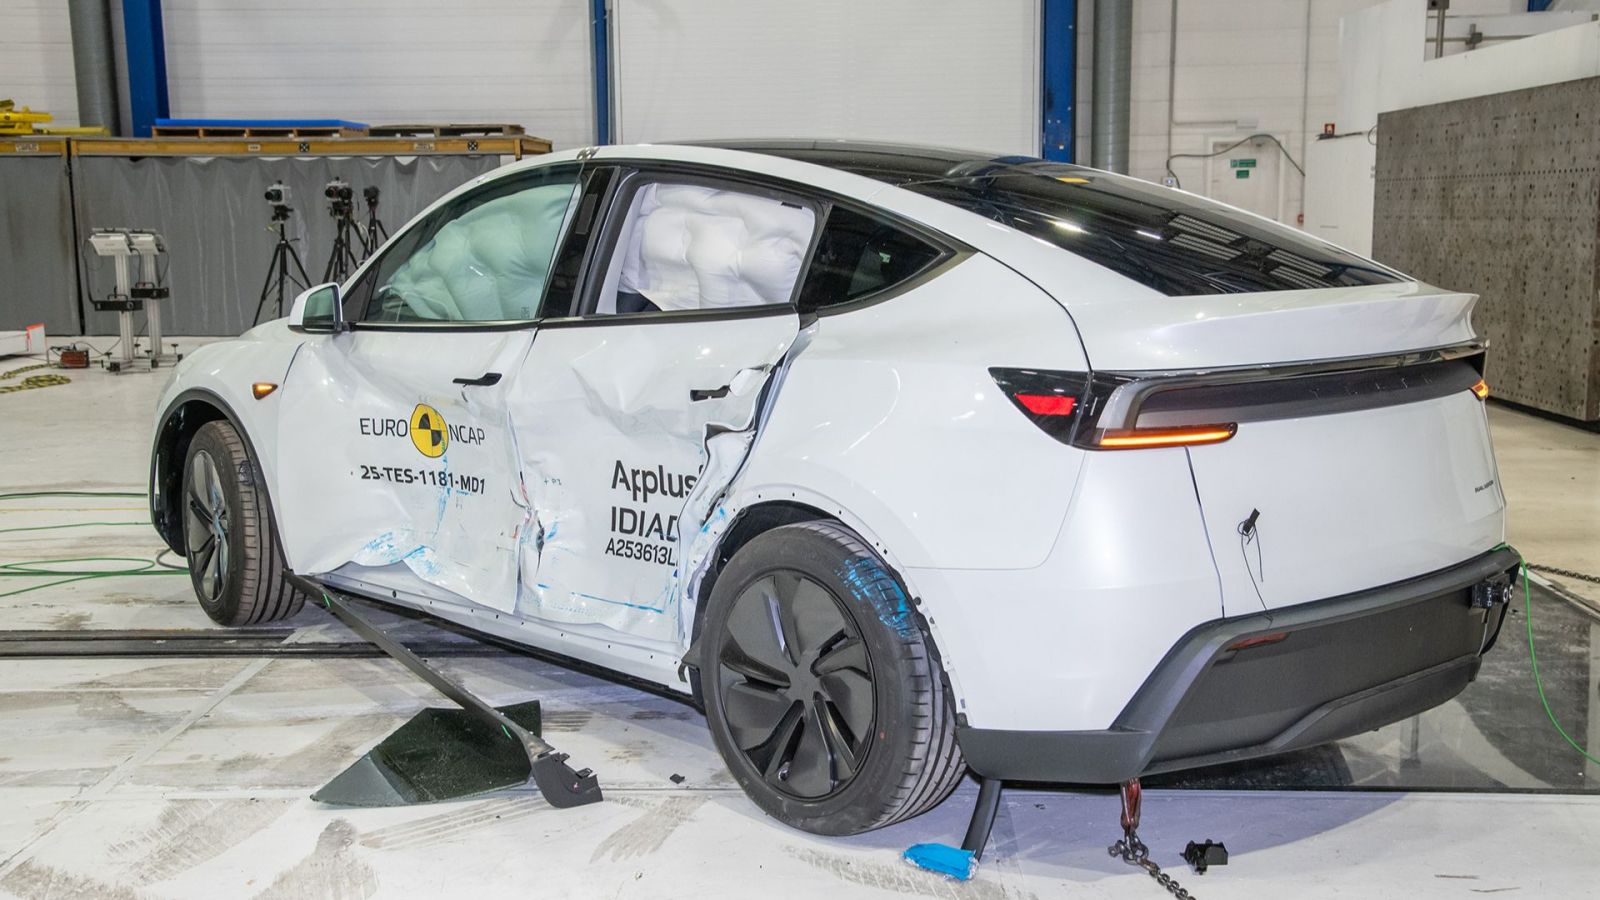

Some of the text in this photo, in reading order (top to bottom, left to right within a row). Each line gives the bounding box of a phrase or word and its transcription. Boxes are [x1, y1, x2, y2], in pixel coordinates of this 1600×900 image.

[359, 418, 485, 445] EURO NCAP
[360, 465, 485, 494] 25-TES-1181-MD1
[605, 537, 678, 567] A253613L
